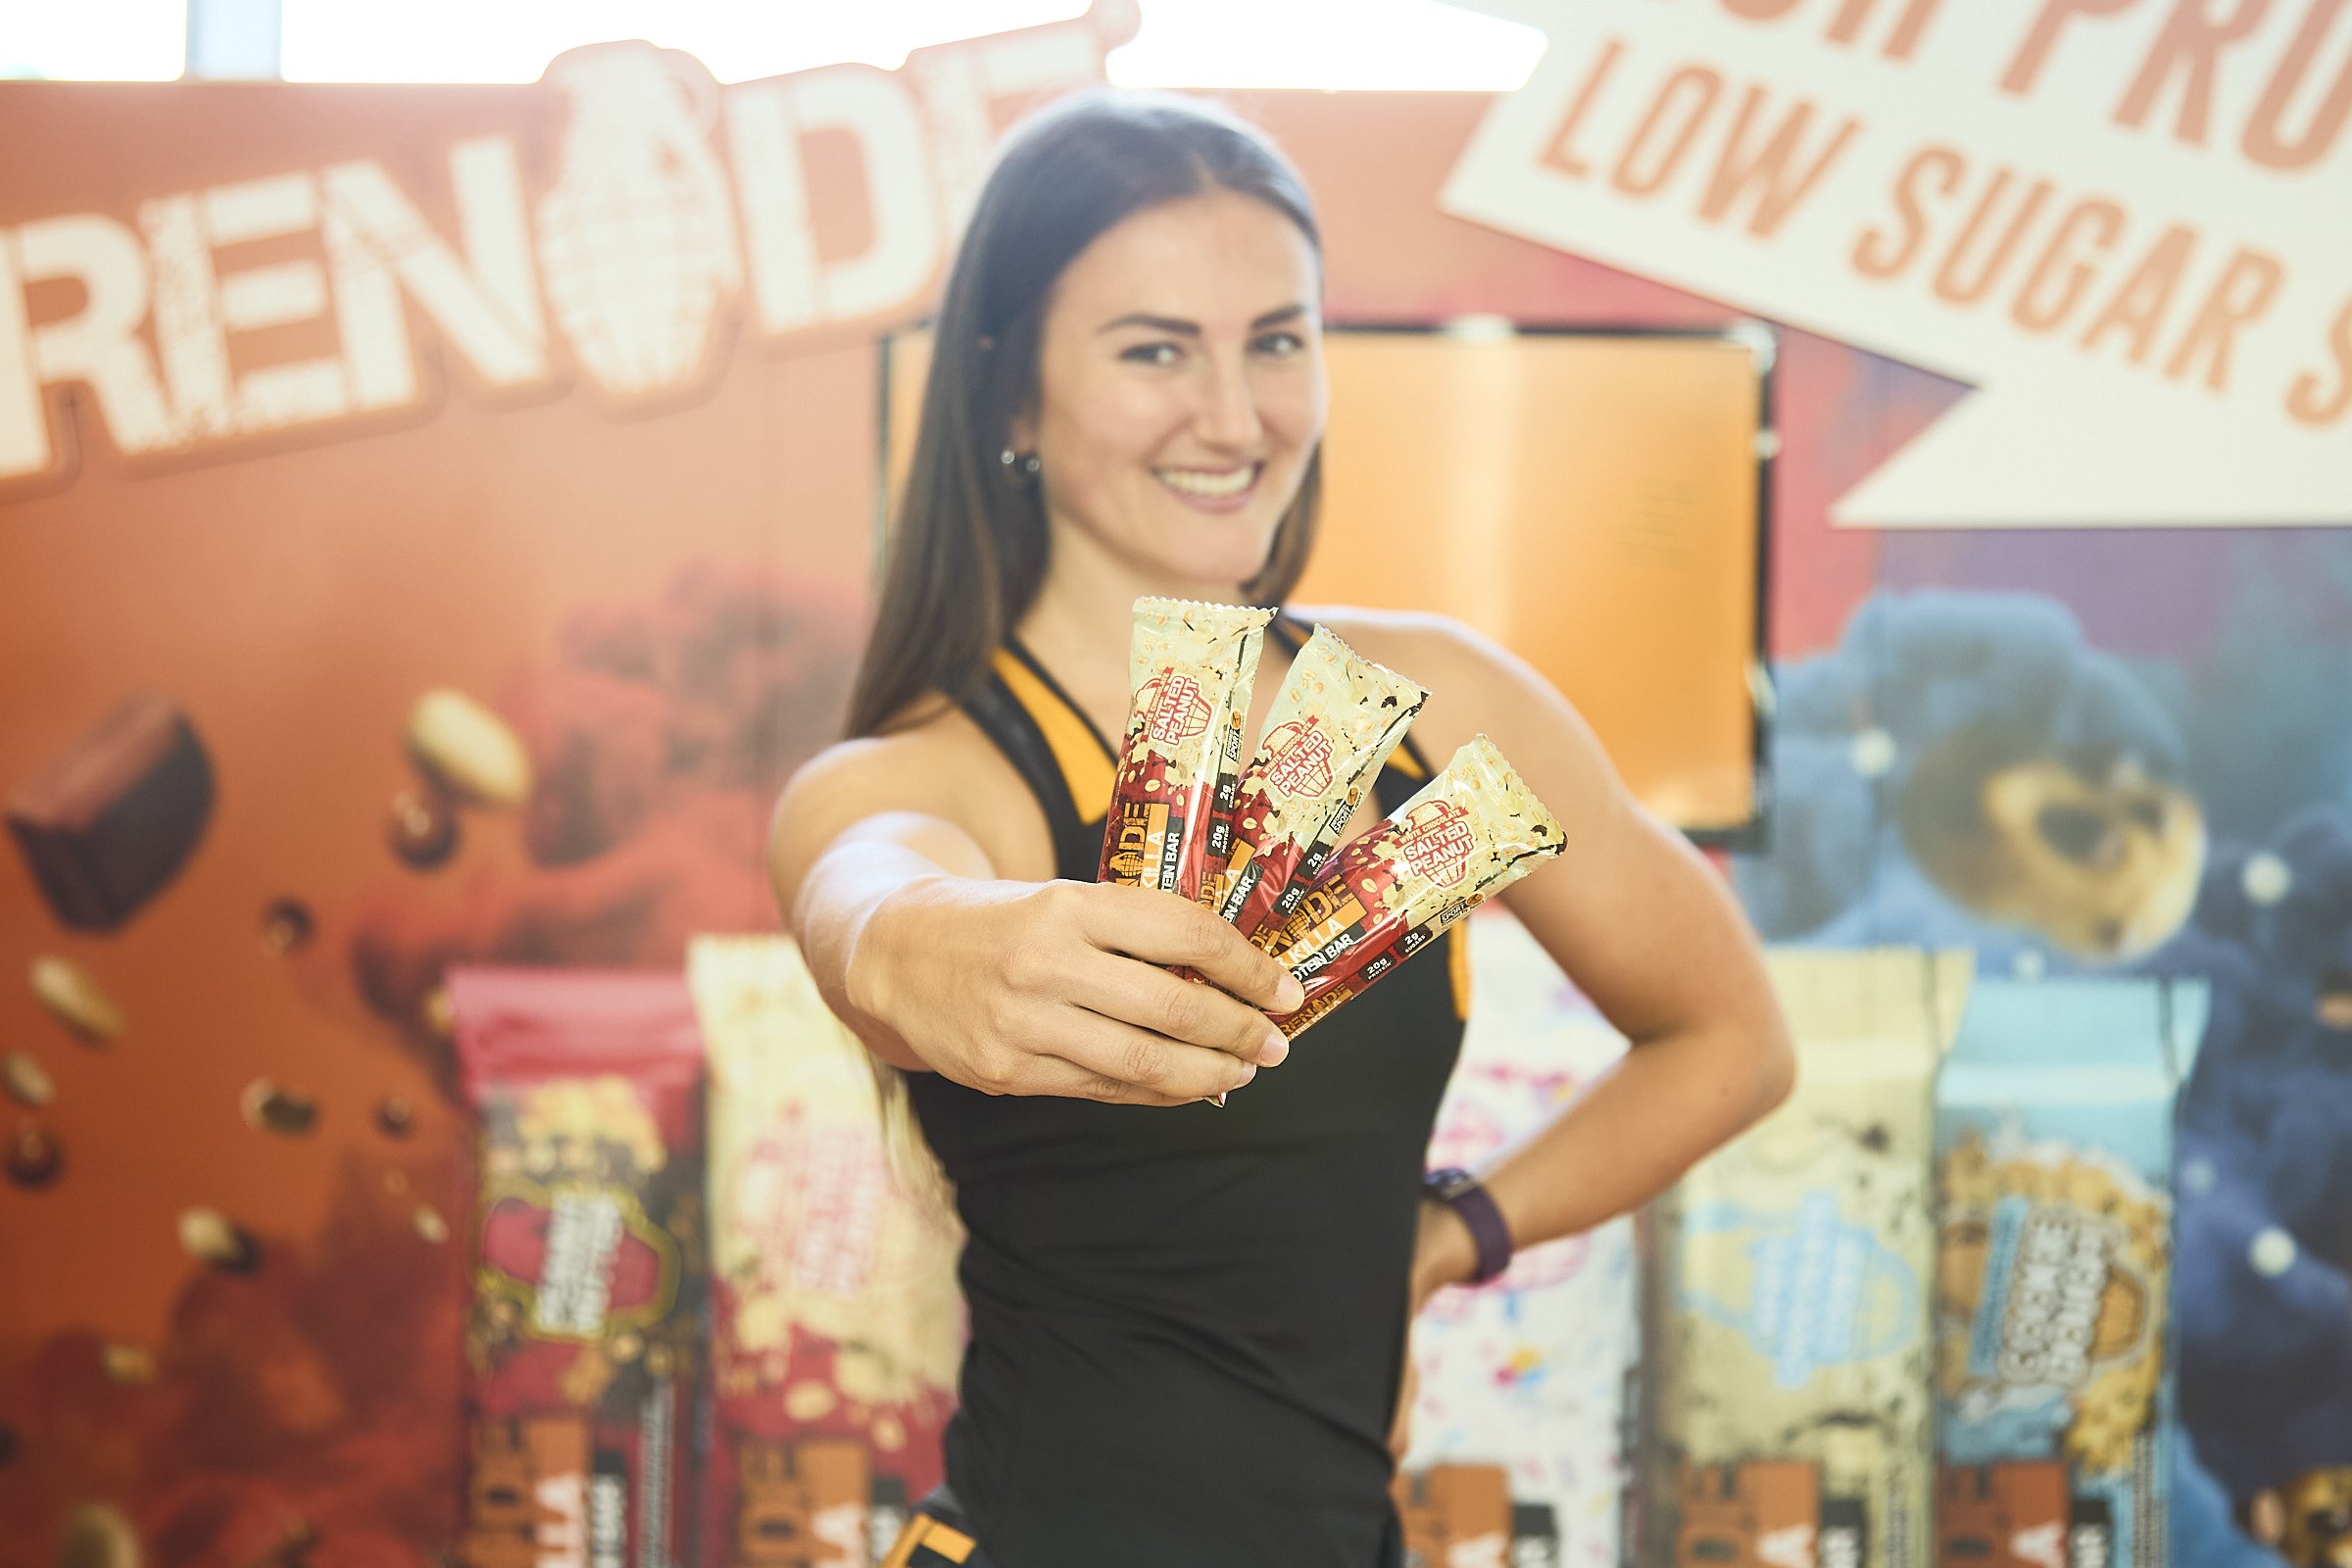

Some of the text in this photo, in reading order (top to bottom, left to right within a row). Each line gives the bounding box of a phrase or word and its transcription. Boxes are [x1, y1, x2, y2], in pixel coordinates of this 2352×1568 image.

[1535, 36, 1864, 240] LOW
[1848, 144, 2286, 396] SUGAR
[1151, 672, 1171, 712] CHOCOLATE
[1152, 676, 1185, 741] SALTED
[1165, 680, 1198, 744] PEANUT
[1263, 755, 1282, 773] WHITE
[1271, 731, 1323, 784] SALTED
[1279, 740, 1332, 797] PEANUT
[1220, 785, 1232, 801] 2g
[1334, 807, 1353, 833] SPORT
[1399, 809, 1462, 845] WHITE CHOCOLATE
[1165, 832, 1180, 859] BAR
[1212, 826, 1224, 849] 20g
[1404, 820, 1469, 859] SALTED
[1307, 852, 1322, 868] 2g
[1410, 836, 1473, 876] PEANUT
[1232, 875, 1254, 906] BAR
[1282, 887, 1299, 909] 20g
[1289, 919, 1347, 965] KILLA
[1326, 933, 1354, 961] BAR
[1405, 932, 1419, 946] 2g
[1405, 934, 1426, 954] SUGARS
[1367, 957, 1388, 975] 20g
[1368, 960, 1393, 980] PROTEIN
